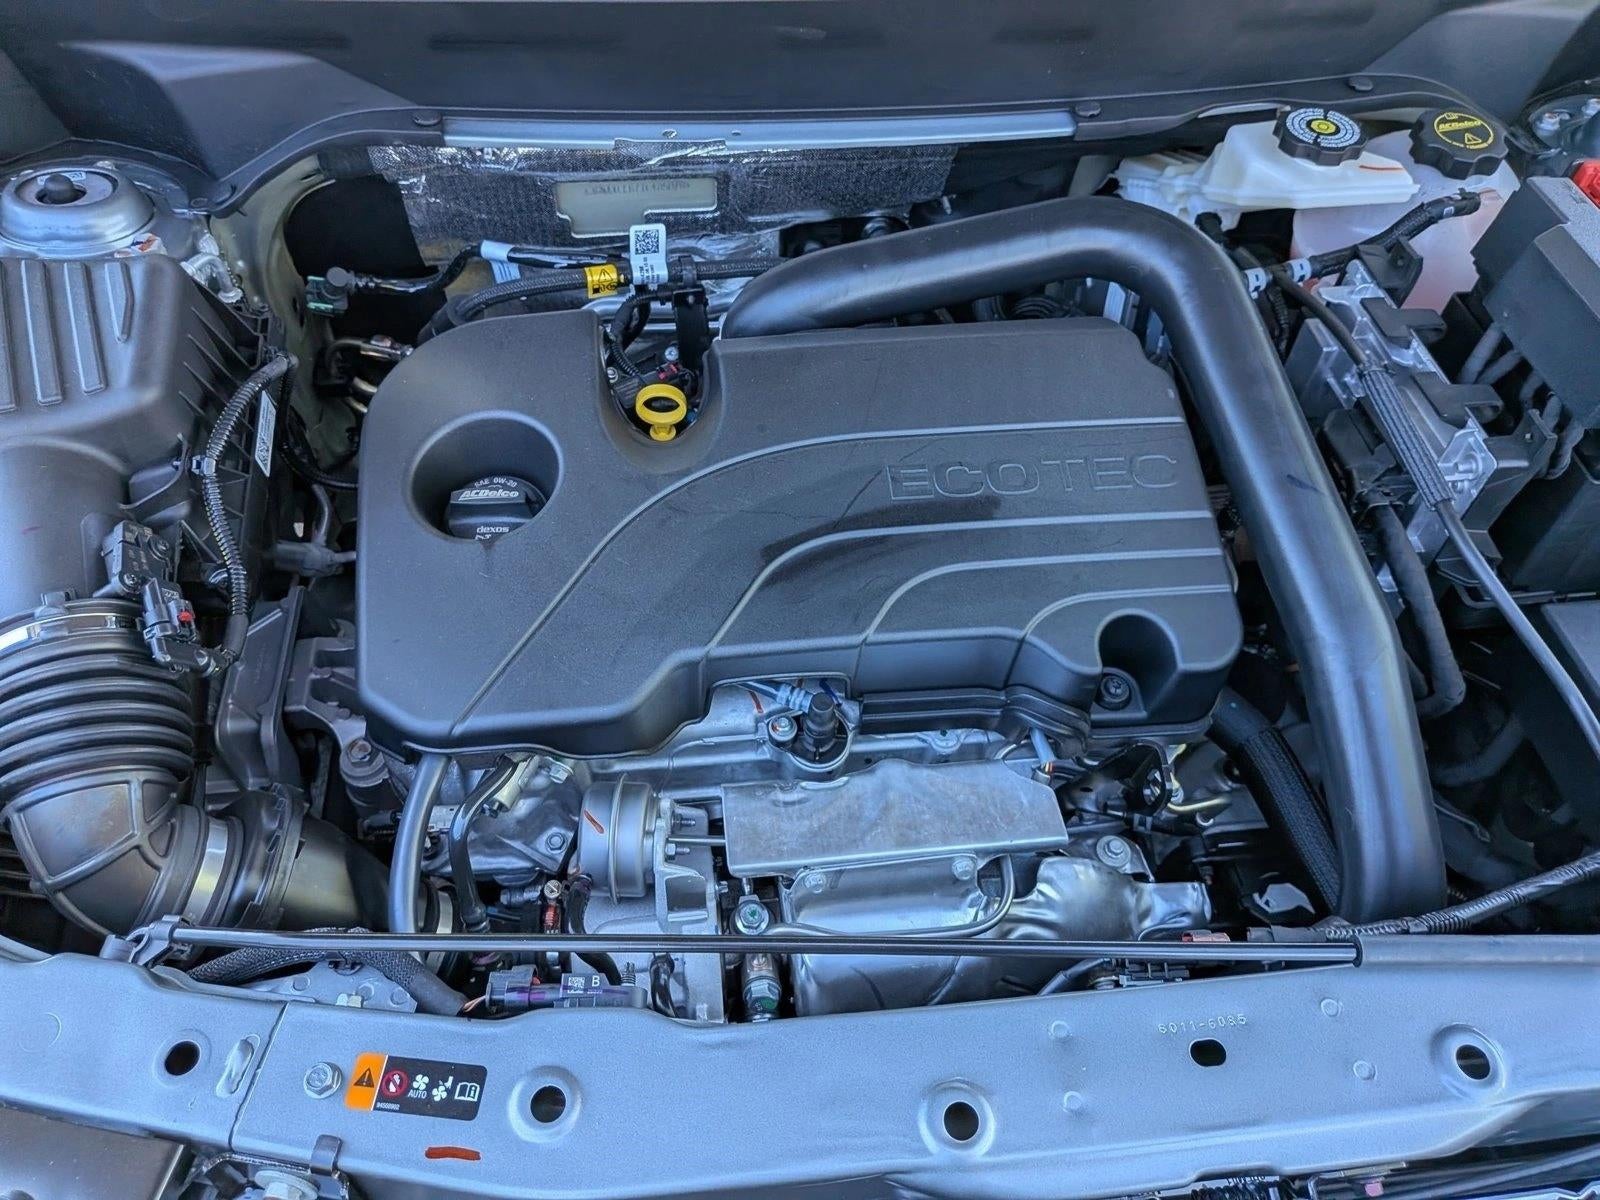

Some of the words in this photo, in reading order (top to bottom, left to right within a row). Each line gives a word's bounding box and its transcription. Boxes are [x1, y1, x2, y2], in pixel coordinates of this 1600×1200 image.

[474, 478, 490, 489] SAE
[493, 477, 518, 489] 0W-20
[887, 454, 1179, 500] ECOTEC
[459, 488, 519, 501] ACDelco
[476, 525, 510, 534] dexos
[591, 975, 601, 987] B
[407, 1088, 428, 1099] AUTO
